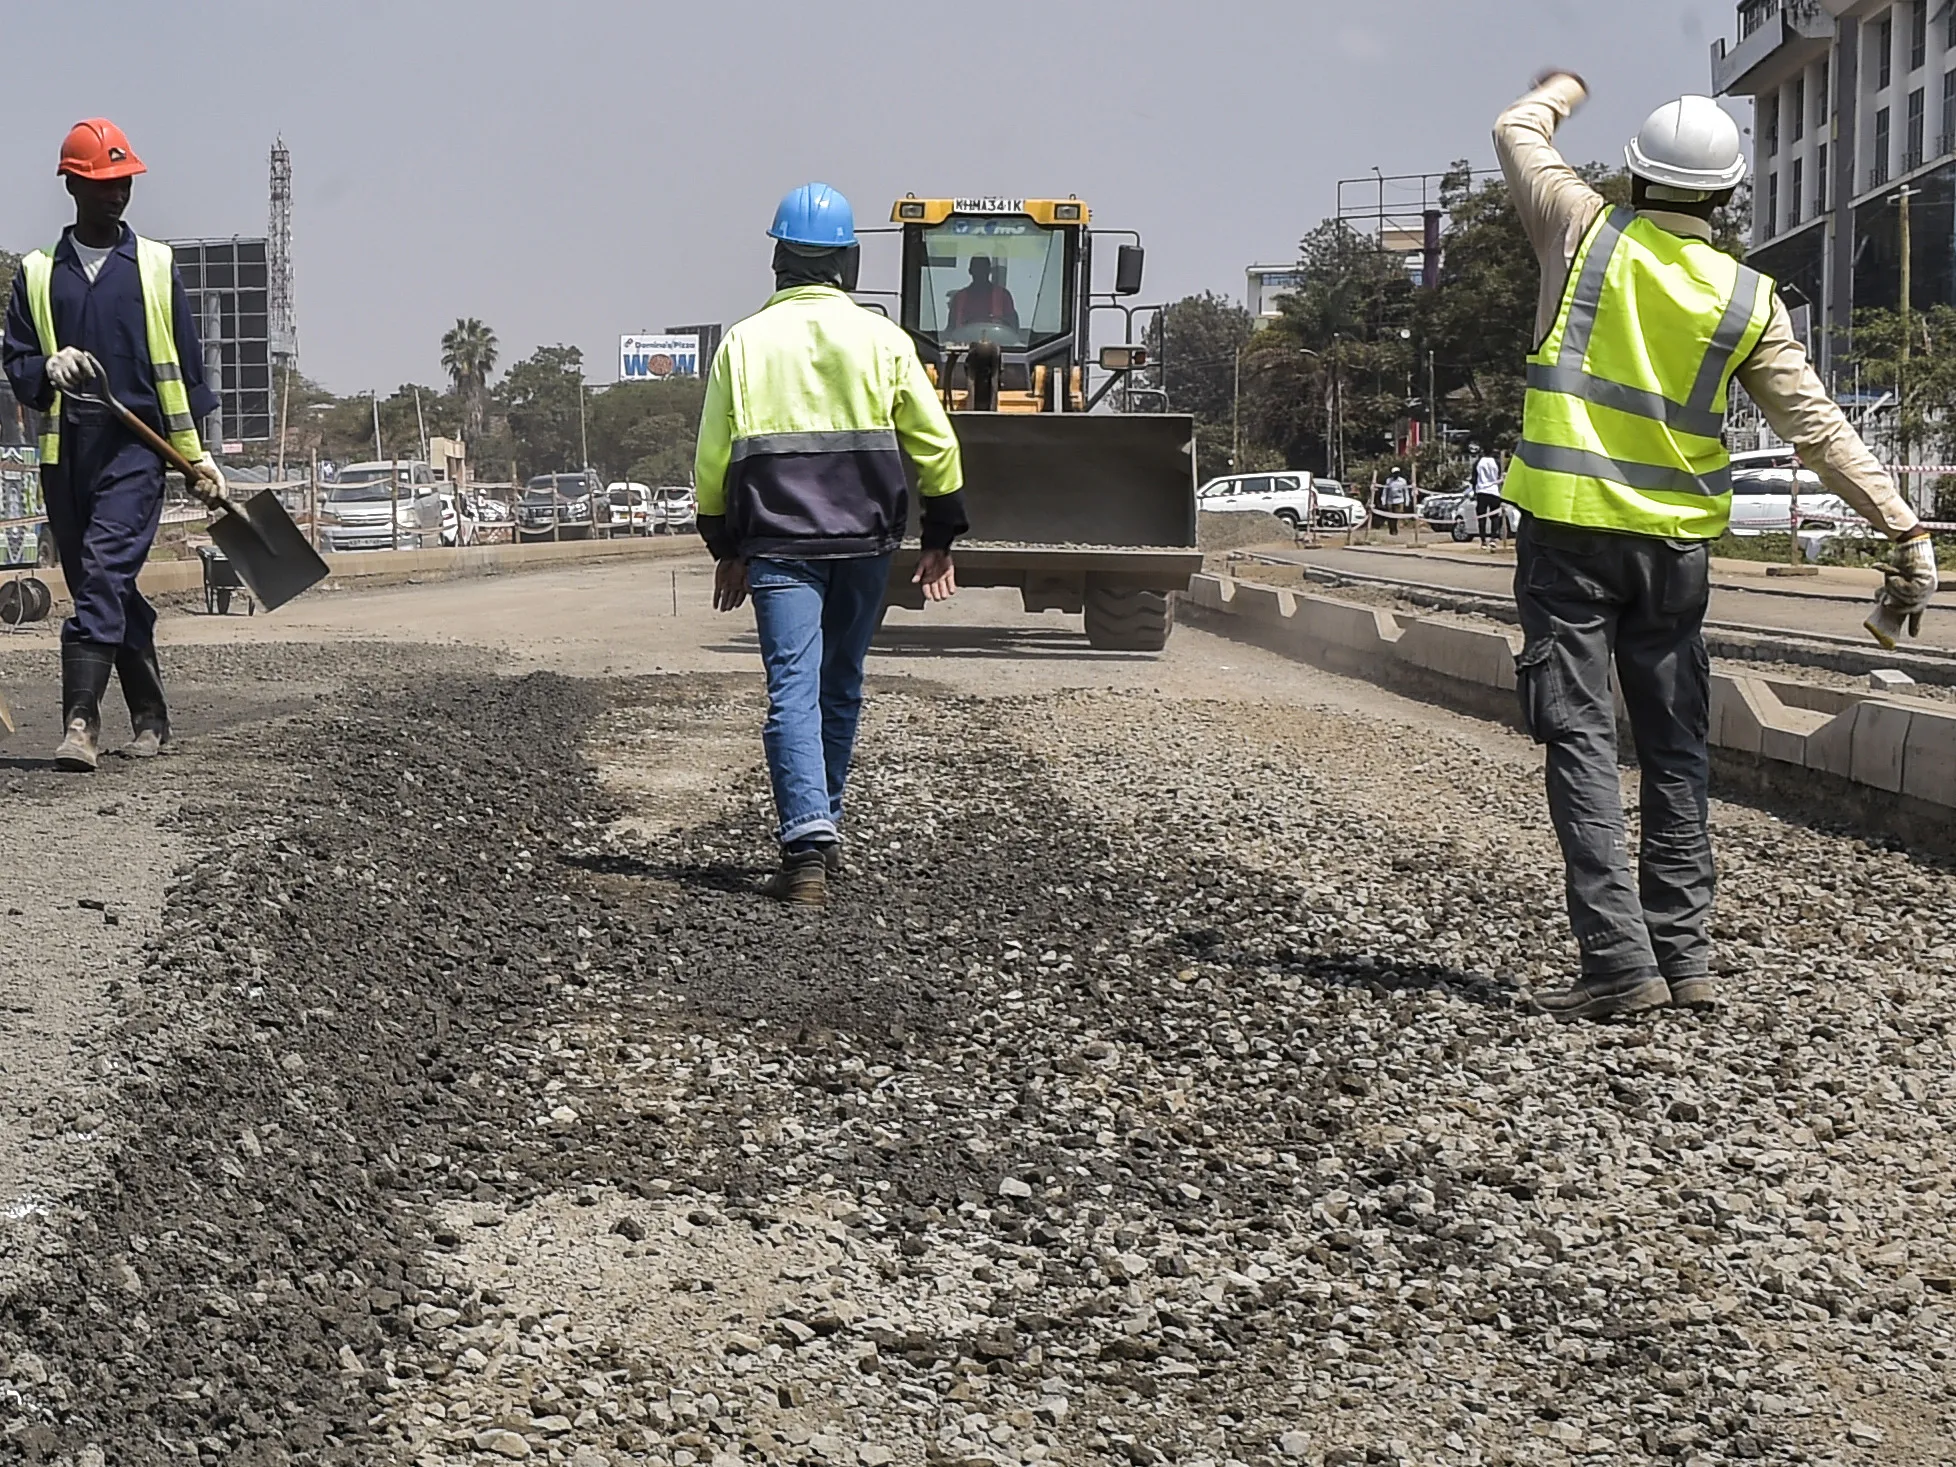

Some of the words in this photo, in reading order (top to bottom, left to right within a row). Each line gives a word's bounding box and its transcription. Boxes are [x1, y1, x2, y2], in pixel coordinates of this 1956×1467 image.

[635, 340, 672, 349] Domino's
[673, 340, 696, 349] Pizza
[623, 353, 696, 377] WOW
